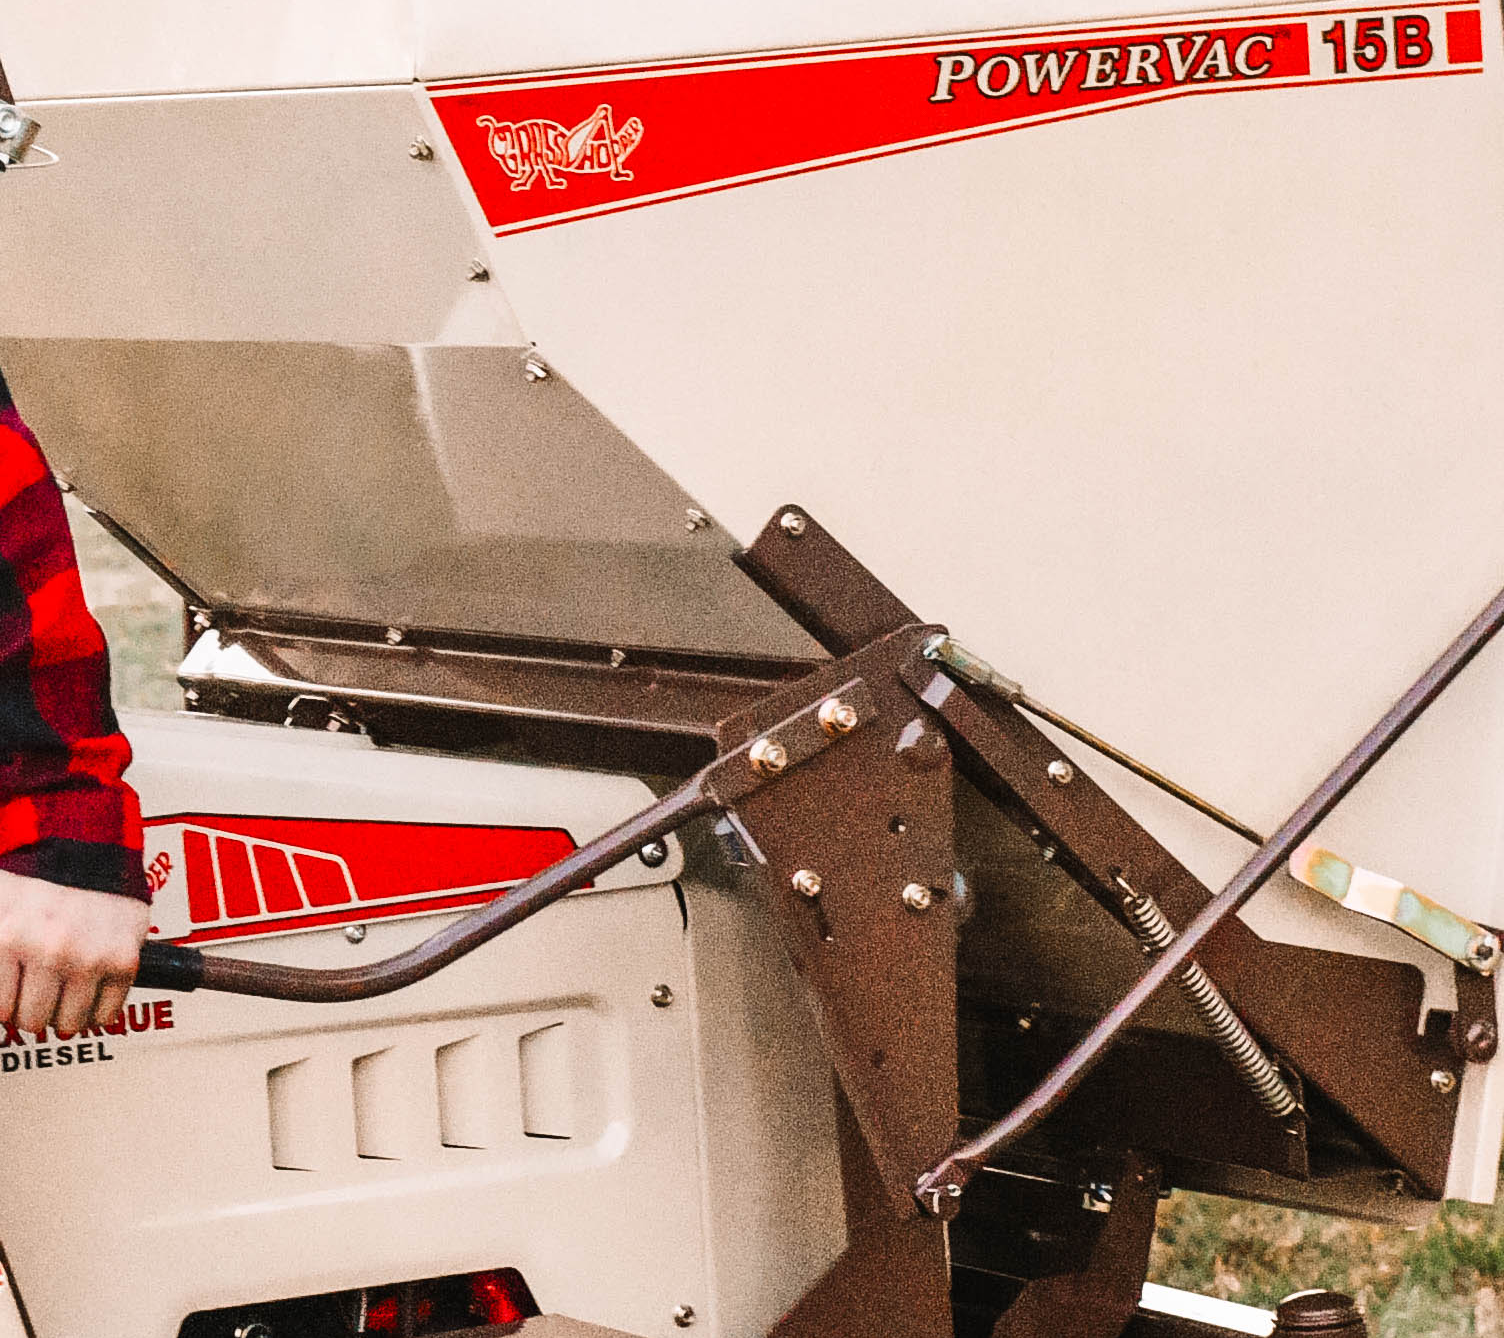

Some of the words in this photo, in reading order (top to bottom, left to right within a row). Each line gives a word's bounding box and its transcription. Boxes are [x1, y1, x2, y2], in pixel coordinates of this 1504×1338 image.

[929, 31, 1274, 103] POWERVAC
[1322, 15, 1433, 74] 15B
[1, 1042, 114, 1072] DIESEL
